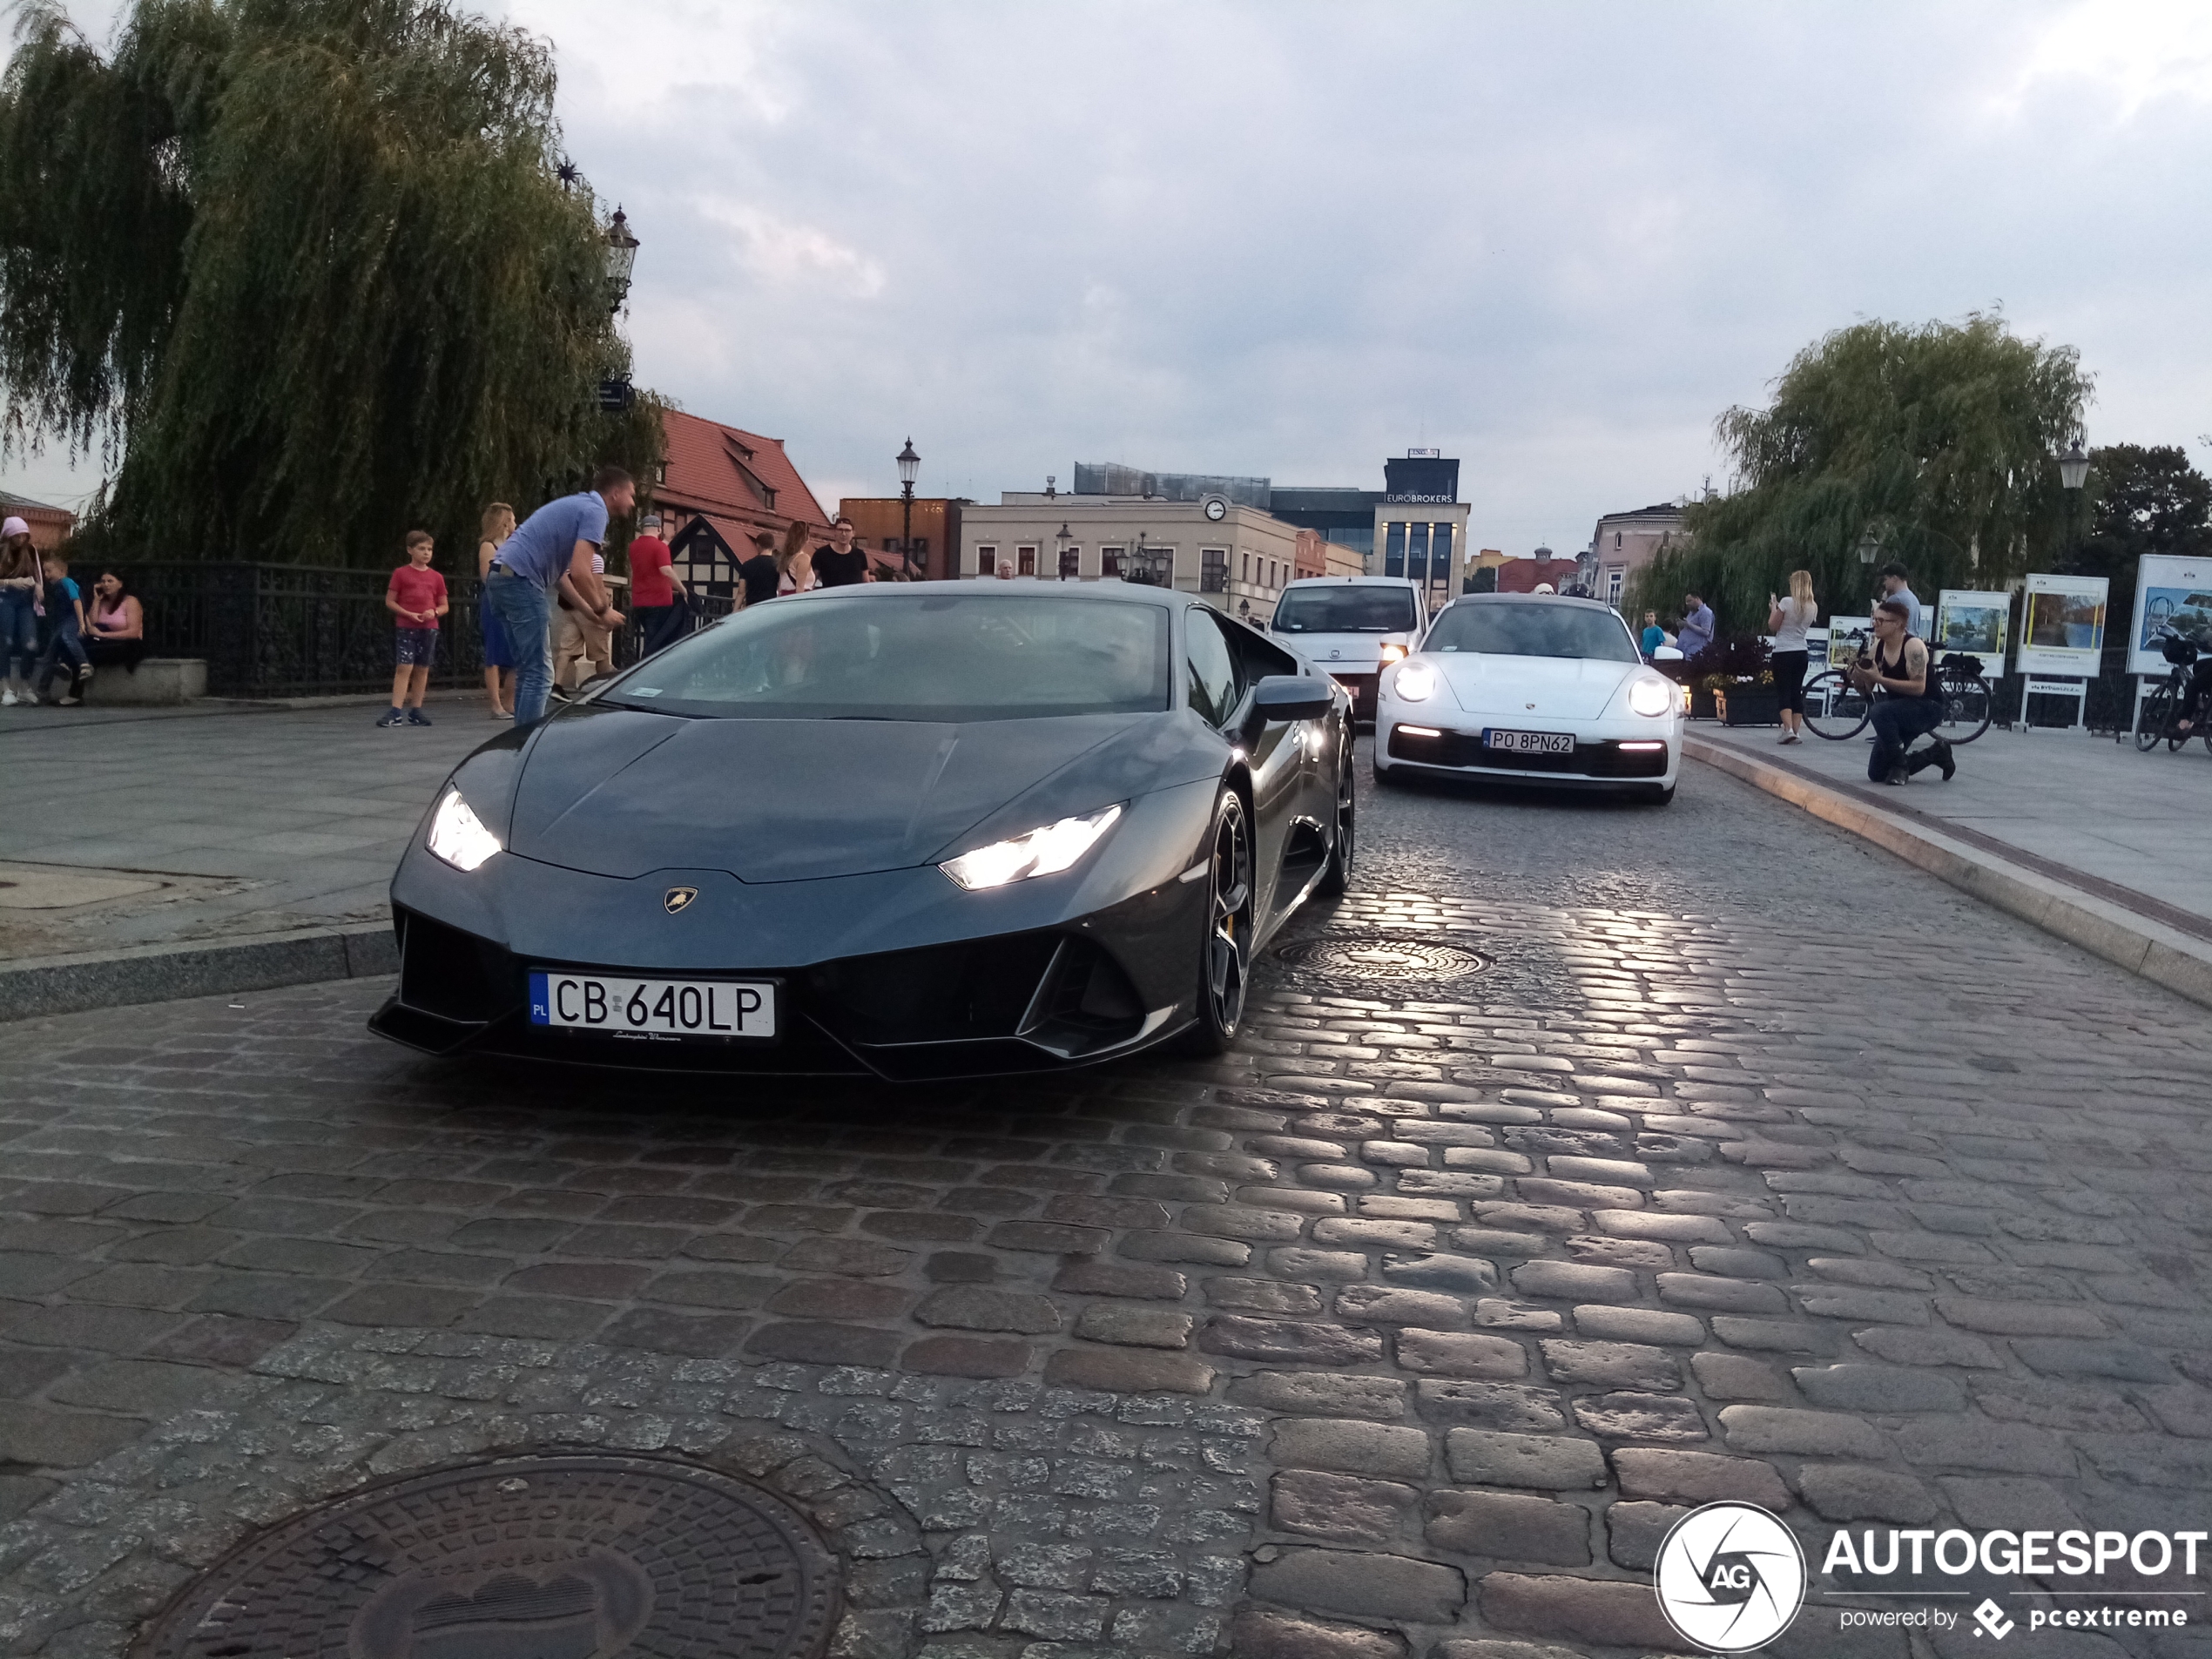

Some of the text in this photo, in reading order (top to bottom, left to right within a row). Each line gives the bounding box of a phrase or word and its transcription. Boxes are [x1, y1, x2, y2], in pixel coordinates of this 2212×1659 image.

[1386, 494, 1453, 503] EUROBROKERS
[1494, 732, 1570, 752] PO 8PN62
[533, 1004, 547, 1016] PL
[556, 980, 762, 1031] CB 640LP
[391, 1504, 615, 1549] DESZCZOWA
